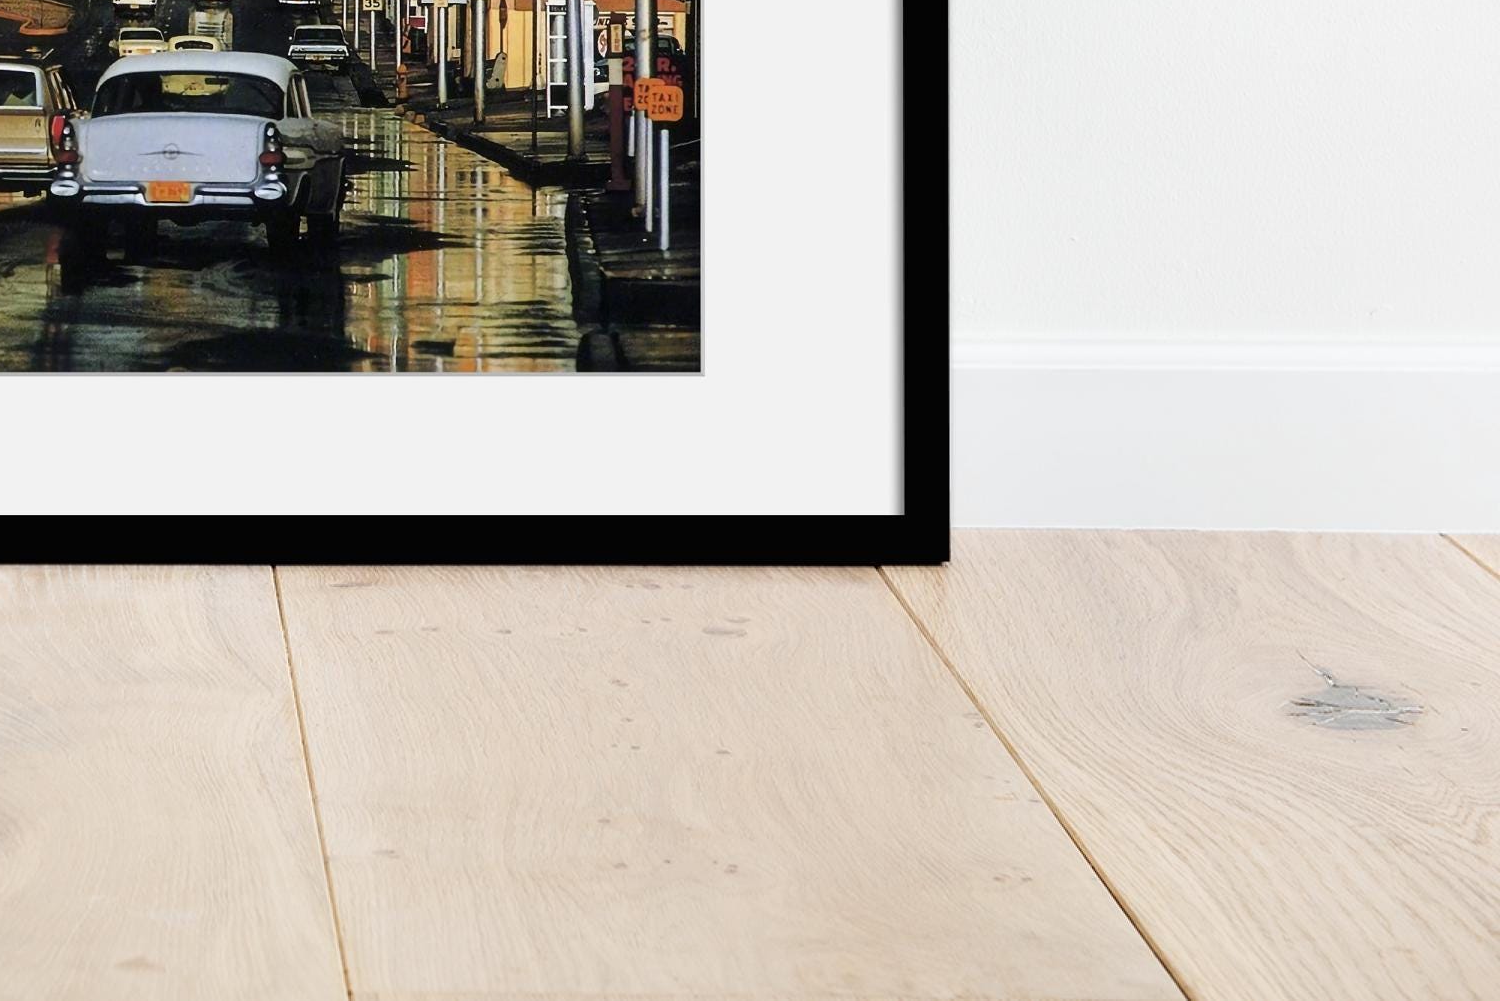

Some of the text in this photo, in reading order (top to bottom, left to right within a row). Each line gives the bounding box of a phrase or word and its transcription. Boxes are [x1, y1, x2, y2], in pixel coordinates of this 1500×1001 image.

[364, 0, 381, 8] 35
[652, 92, 679, 103] TAXI
[651, 104, 679, 115] ZONE
